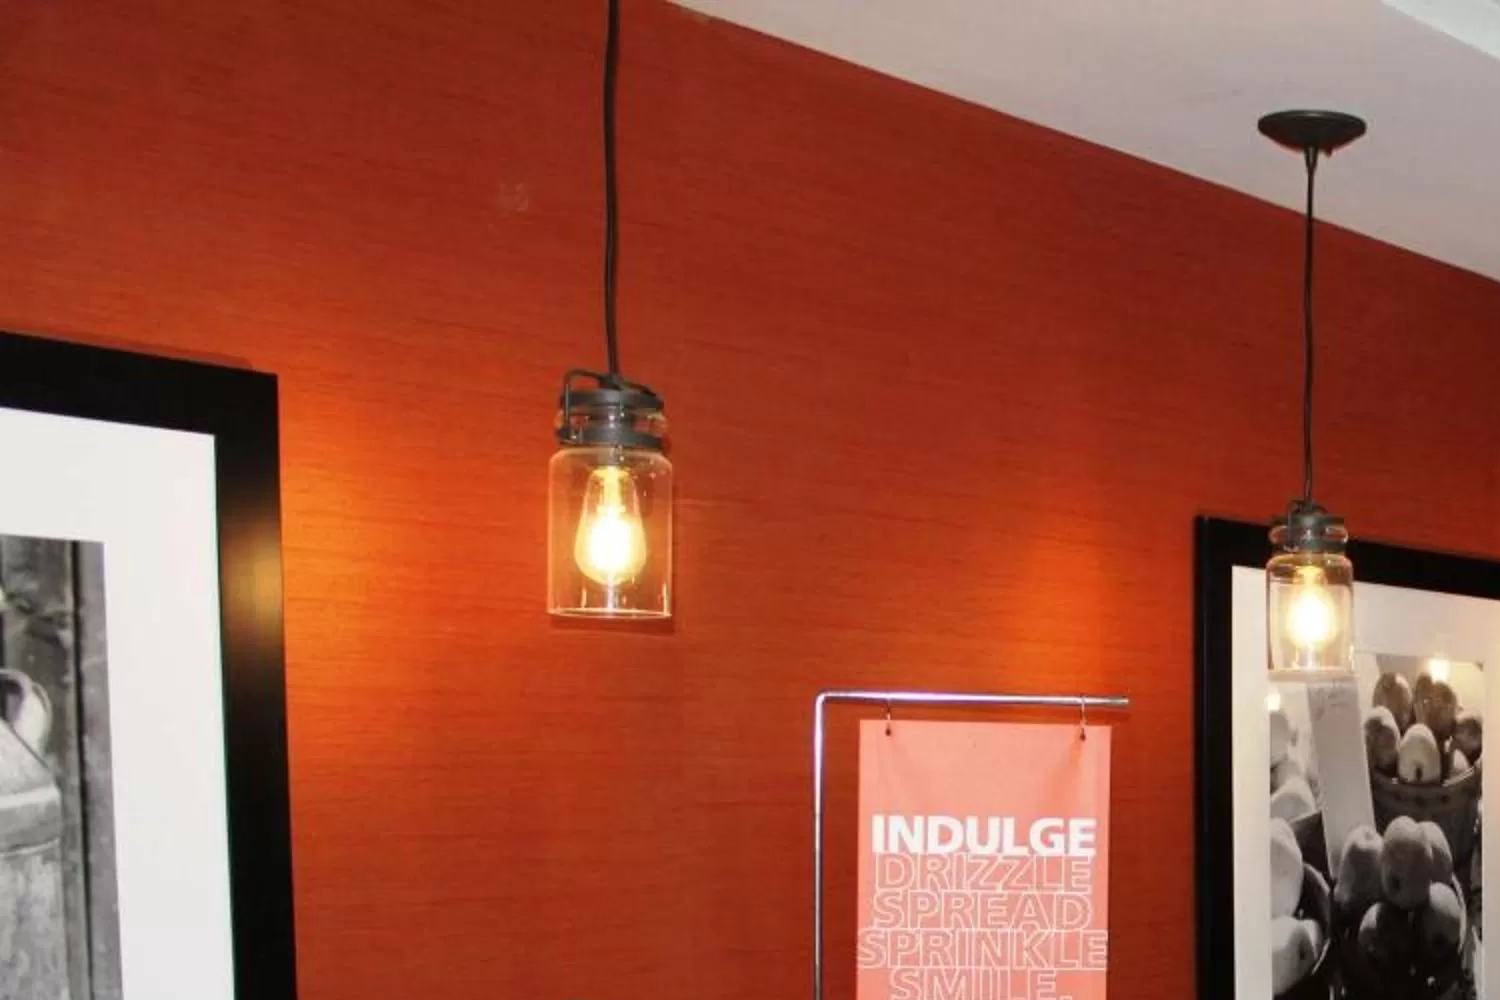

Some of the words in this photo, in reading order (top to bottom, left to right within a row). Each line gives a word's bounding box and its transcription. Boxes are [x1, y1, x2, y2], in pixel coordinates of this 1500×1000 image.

[872, 814, 1097, 857] INDULGE
[875, 853, 1092, 893] DRIZZLE
[872, 890, 1092, 931] SPREAD
[856, 928, 1109, 971] SPRINKLE
